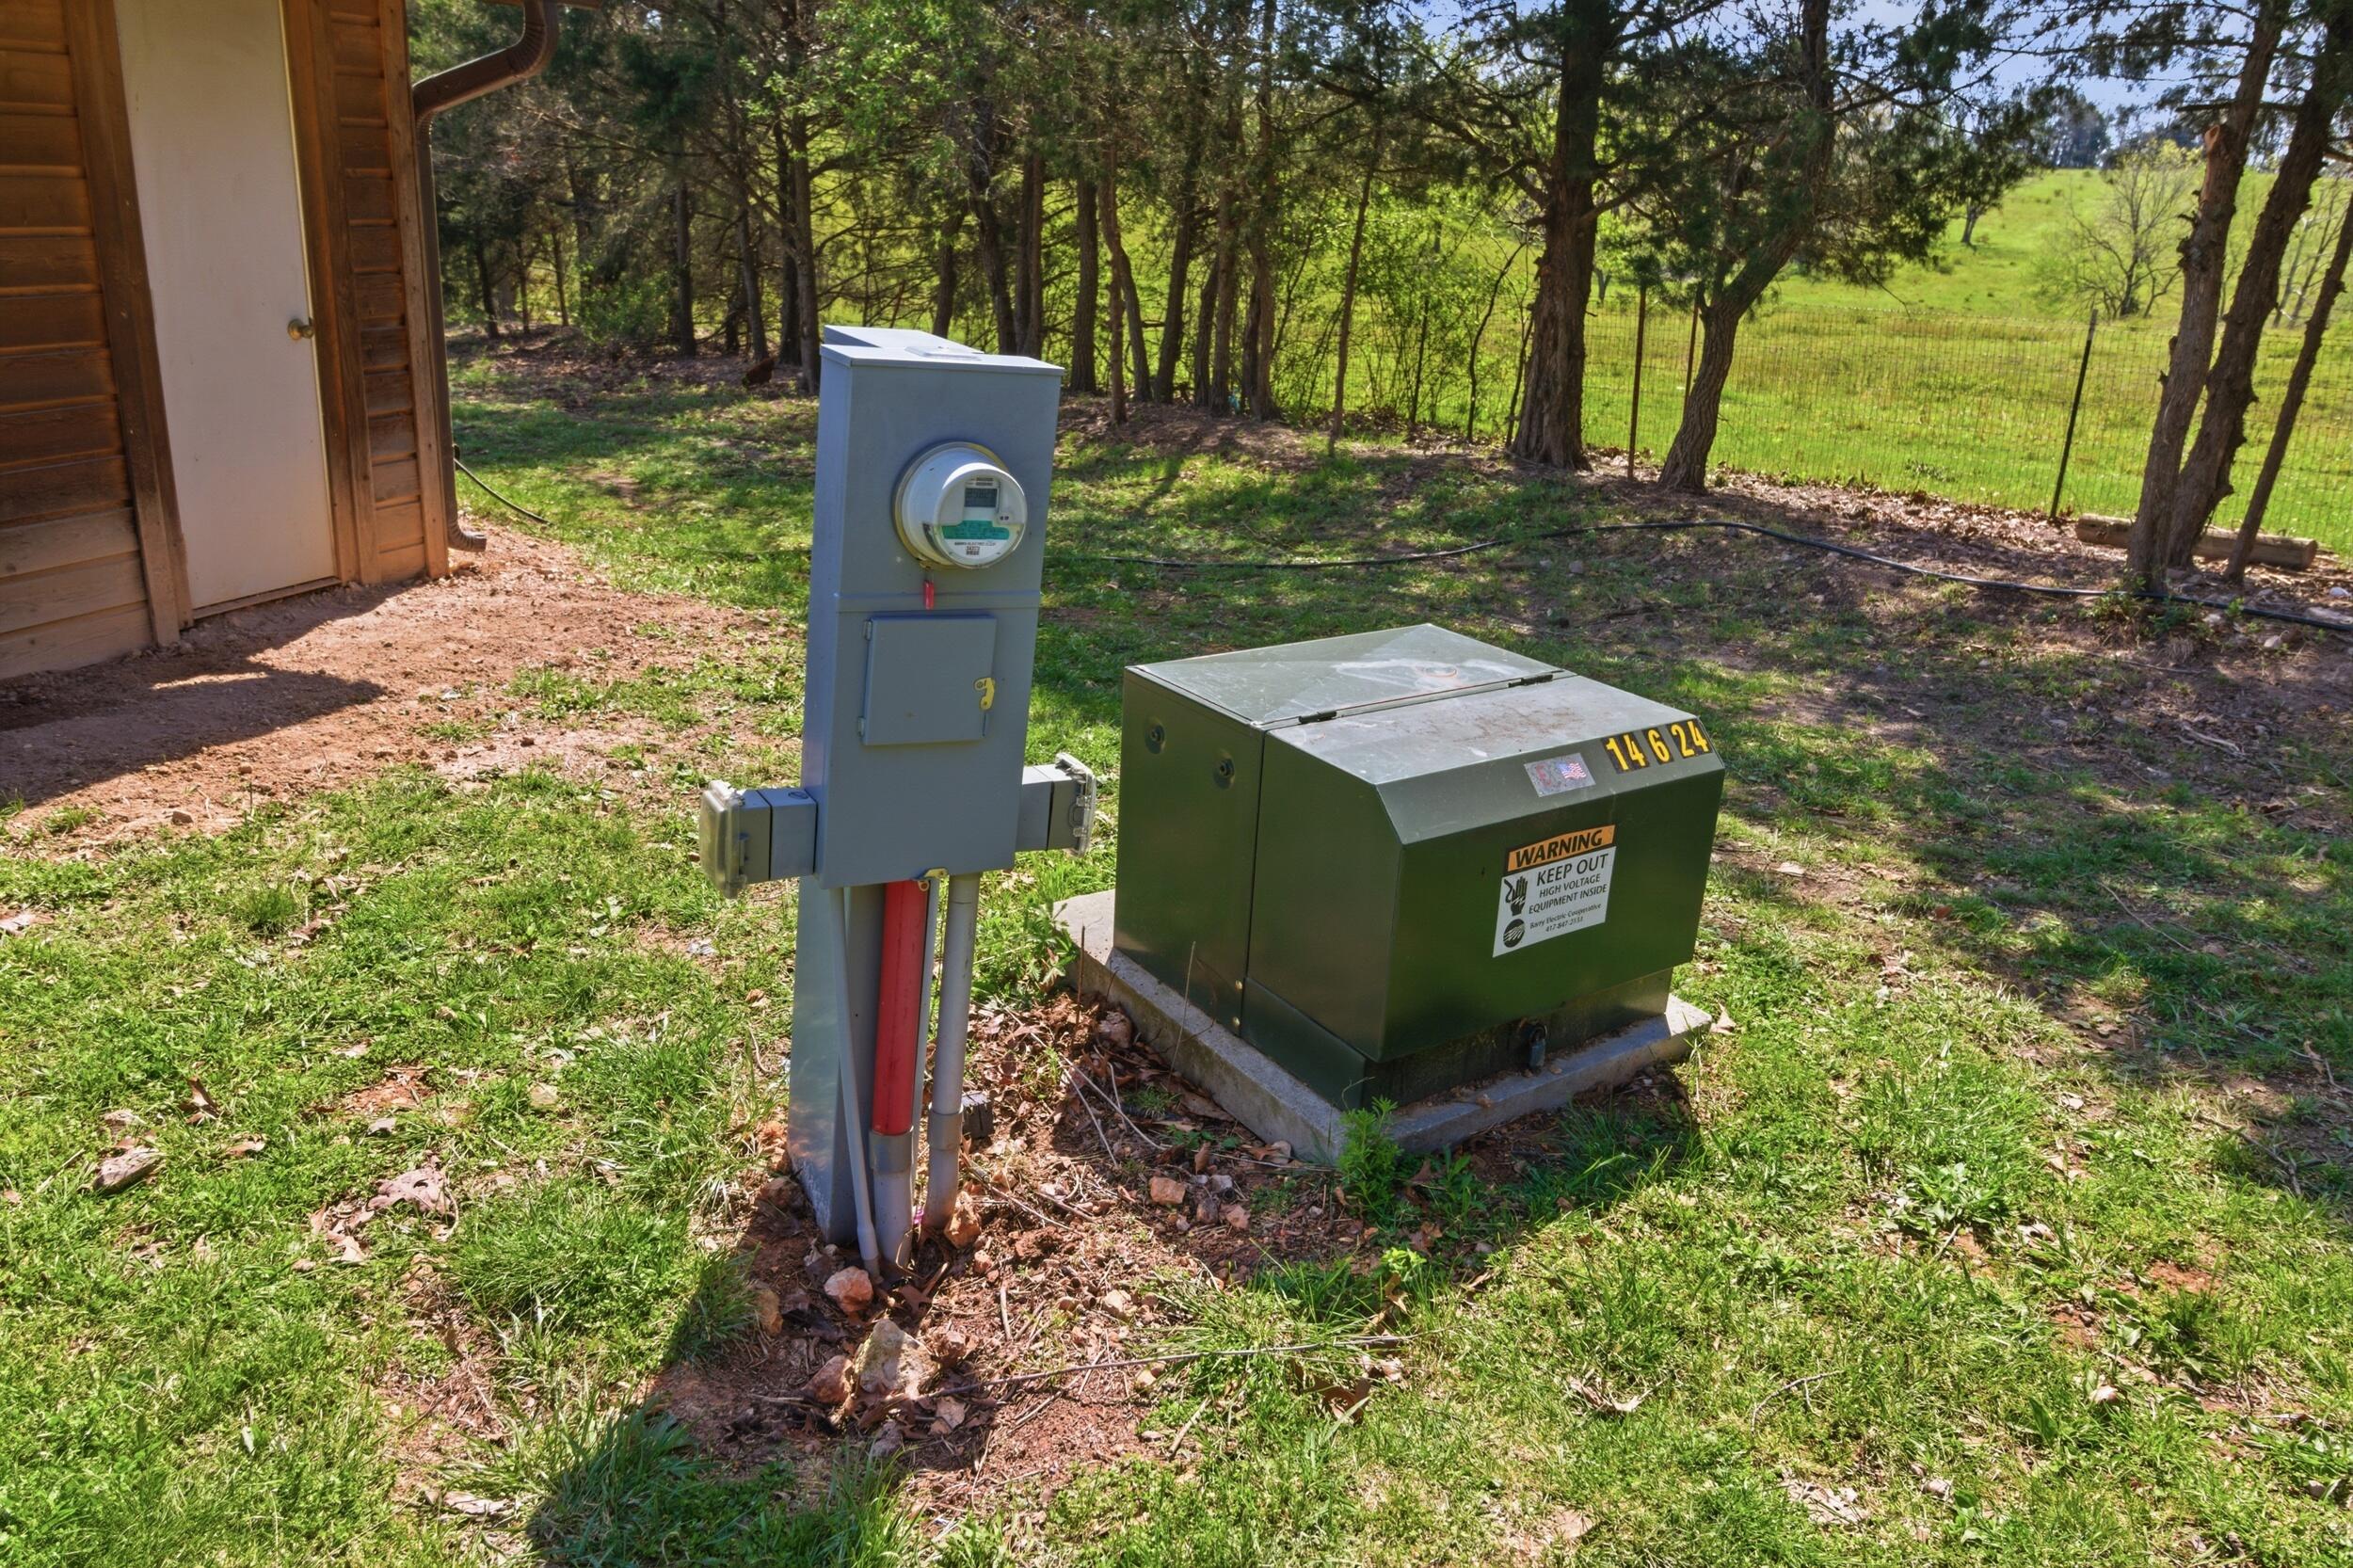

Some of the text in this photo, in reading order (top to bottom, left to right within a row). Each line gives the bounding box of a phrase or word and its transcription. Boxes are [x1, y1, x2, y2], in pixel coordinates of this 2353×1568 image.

[1515, 830, 1603, 868] WARNING
[1536, 854, 1609, 886] KEEP OUT
[1529, 884, 1608, 914] EQUIPMENT INSIDE
[1539, 873, 1601, 898] HIGH VOLTAGE
[1529, 904, 1602, 930] Barry Electric Cooperative
